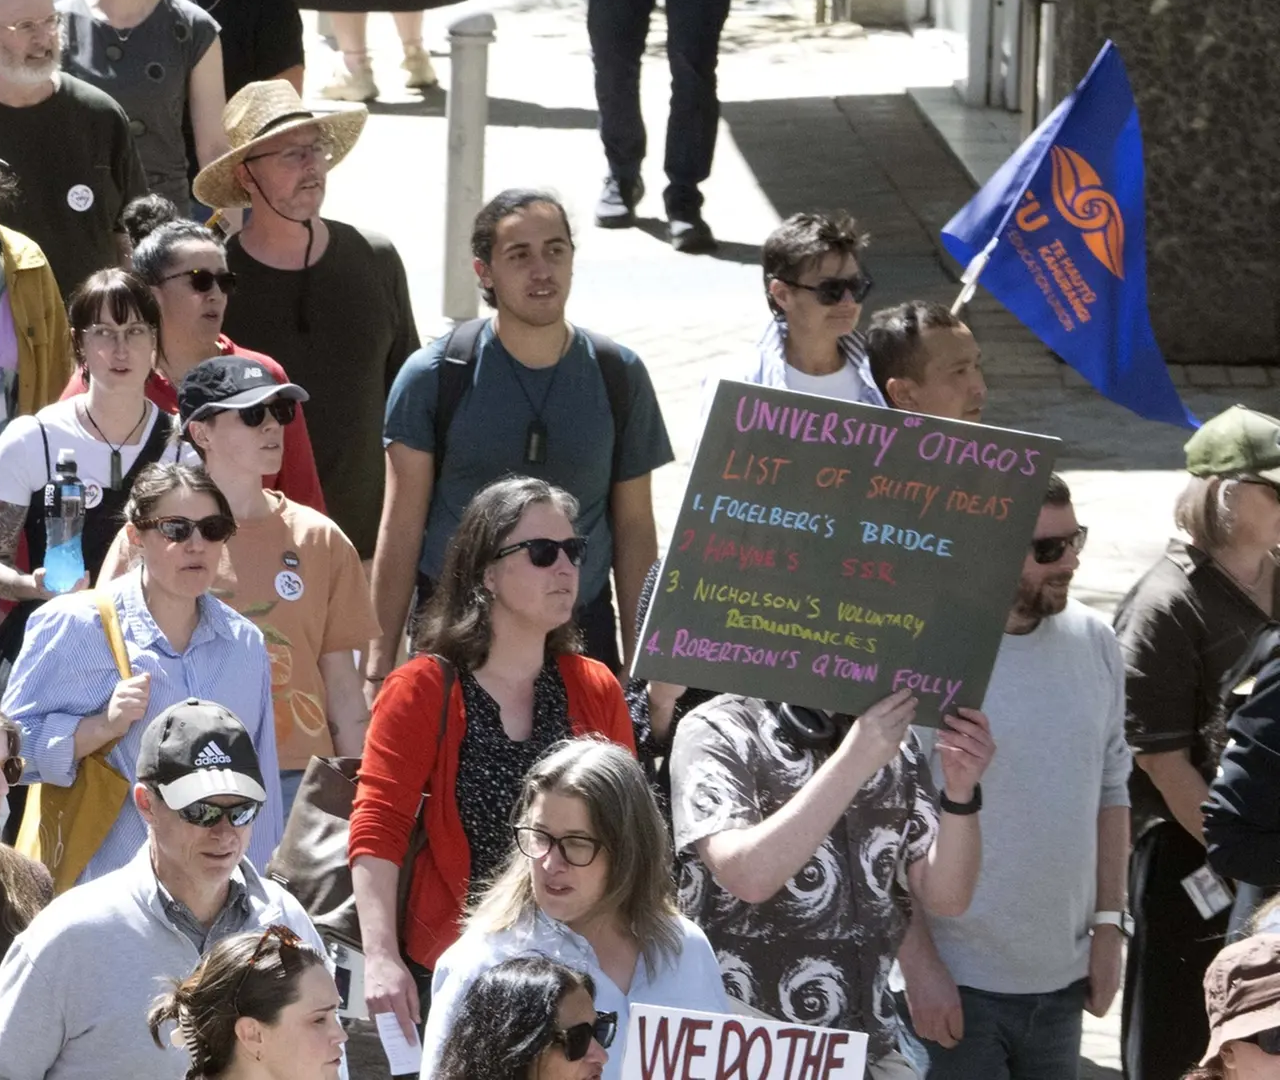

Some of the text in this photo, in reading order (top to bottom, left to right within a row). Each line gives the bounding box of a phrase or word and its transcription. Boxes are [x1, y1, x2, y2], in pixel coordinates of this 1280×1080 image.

[734, 394, 899, 467] UNIVERSITY
[917, 430, 1042, 478] OTAGO'S
[721, 449, 793, 486] LIST
[815, 466, 851, 490] OF
[709, 495, 837, 540] FOGELBERG'S
[859, 520, 955, 558] BRIDGE
[841, 559, 898, 587] SSR
[693, 578, 821, 620] NICHOLSON'S
[837, 601, 927, 640] VOLUNTARY
[671, 629, 801, 670] ROBERTSON'S
[193, 755, 232, 767] adidas
[638, 1015, 714, 1080] WE
[776, 1027, 850, 1080] THE
